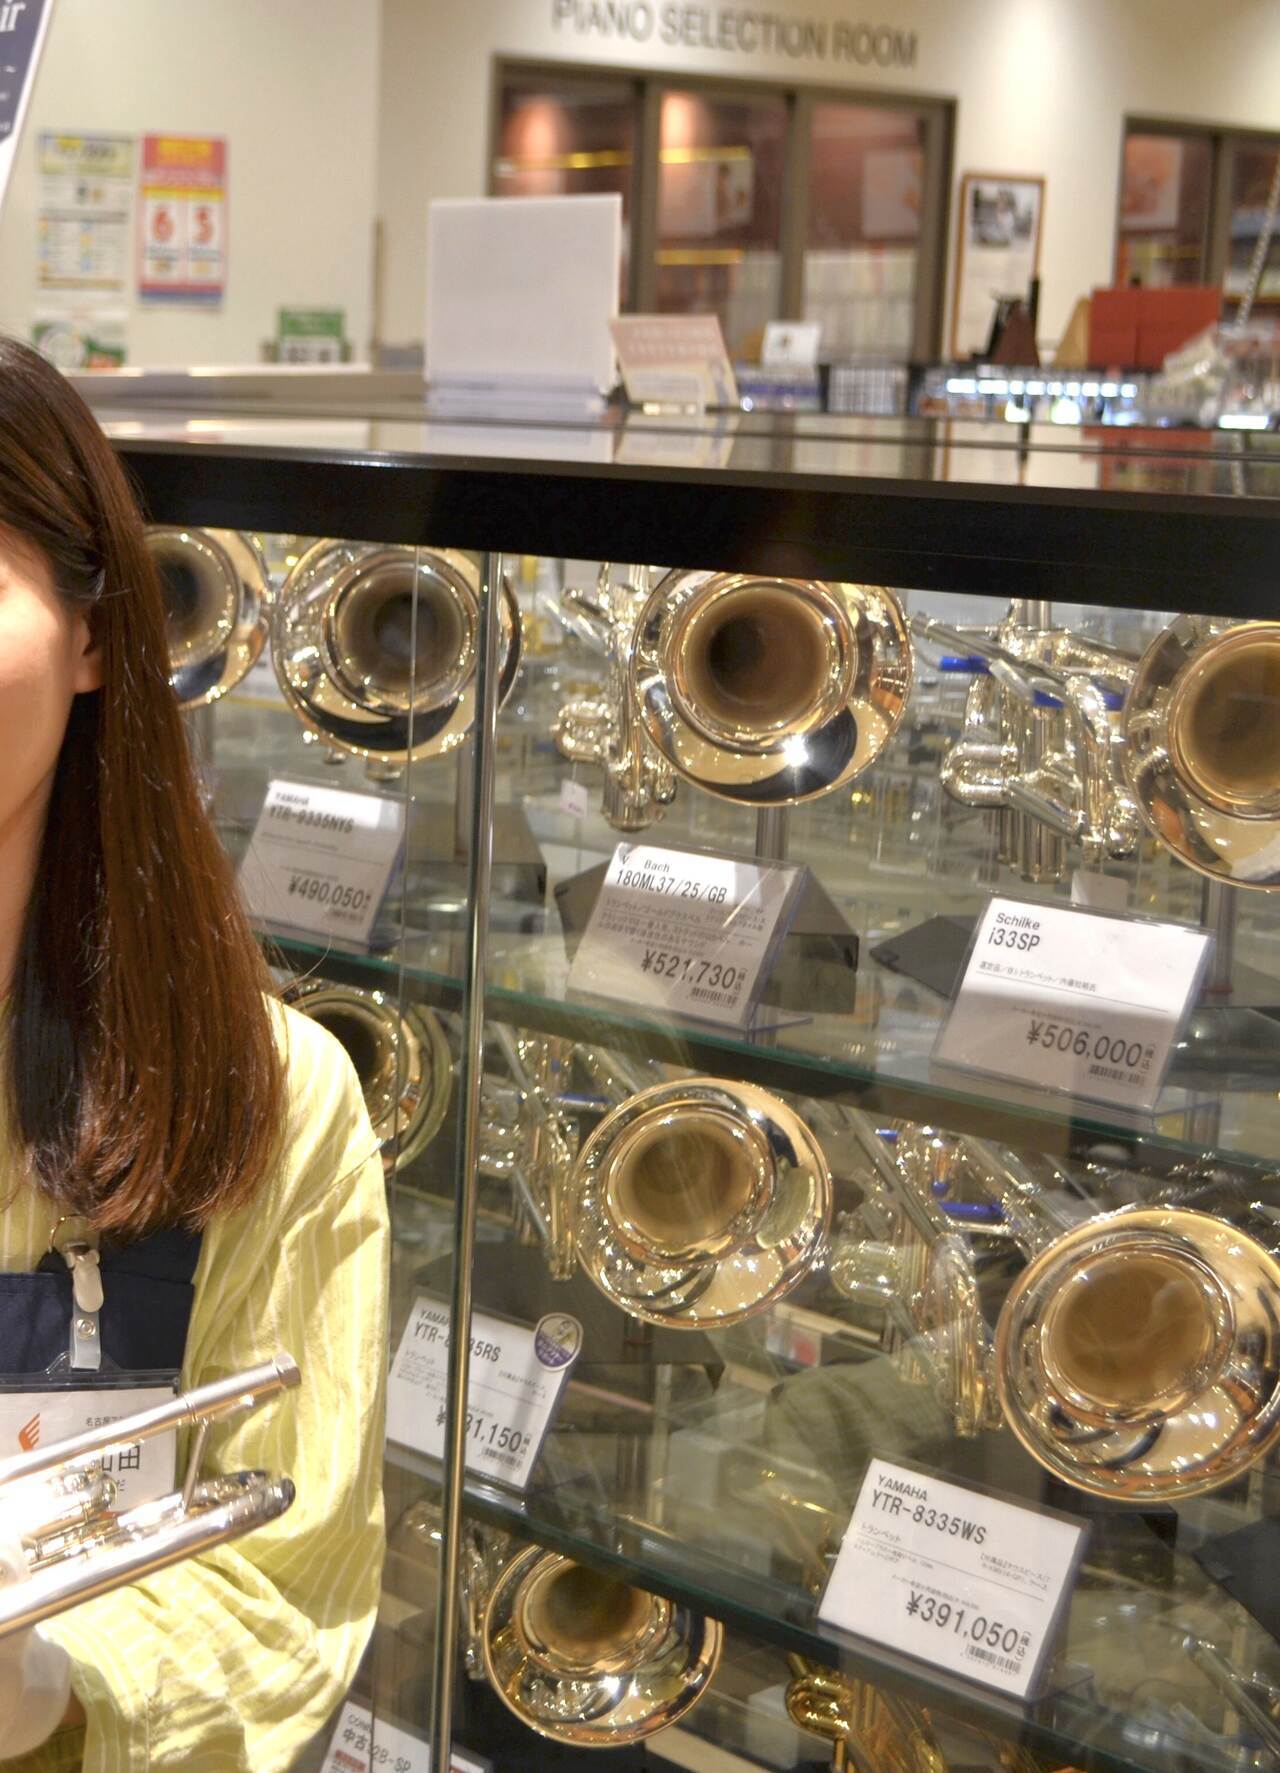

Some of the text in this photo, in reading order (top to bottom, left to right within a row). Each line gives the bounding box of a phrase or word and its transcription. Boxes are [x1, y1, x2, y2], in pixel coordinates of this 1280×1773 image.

[551, 0, 920, 69] PIANO SELECTION ROOM
[643, 859, 671, 873] Bach
[288, 874, 364, 910] ¥490,050
[616, 869, 728, 904] 180ML37/25/GB
[987, 927, 1041, 953] i33SP
[995, 911, 1041, 931] Schilke
[640, 949, 736, 990] ¥521,730
[1026, 1018, 1143, 1069] ¥506,000
[421, 1308, 450, 1327] YAMA
[414, 1321, 502, 1362] YTR-35RS
[436, 1404, 523, 1453] ¥31,150
[877, 1474, 928, 1502] YAMAHA
[870, 1488, 987, 1545] YTR-8335WS
[905, 1590, 1019, 1654] ¥391,050
